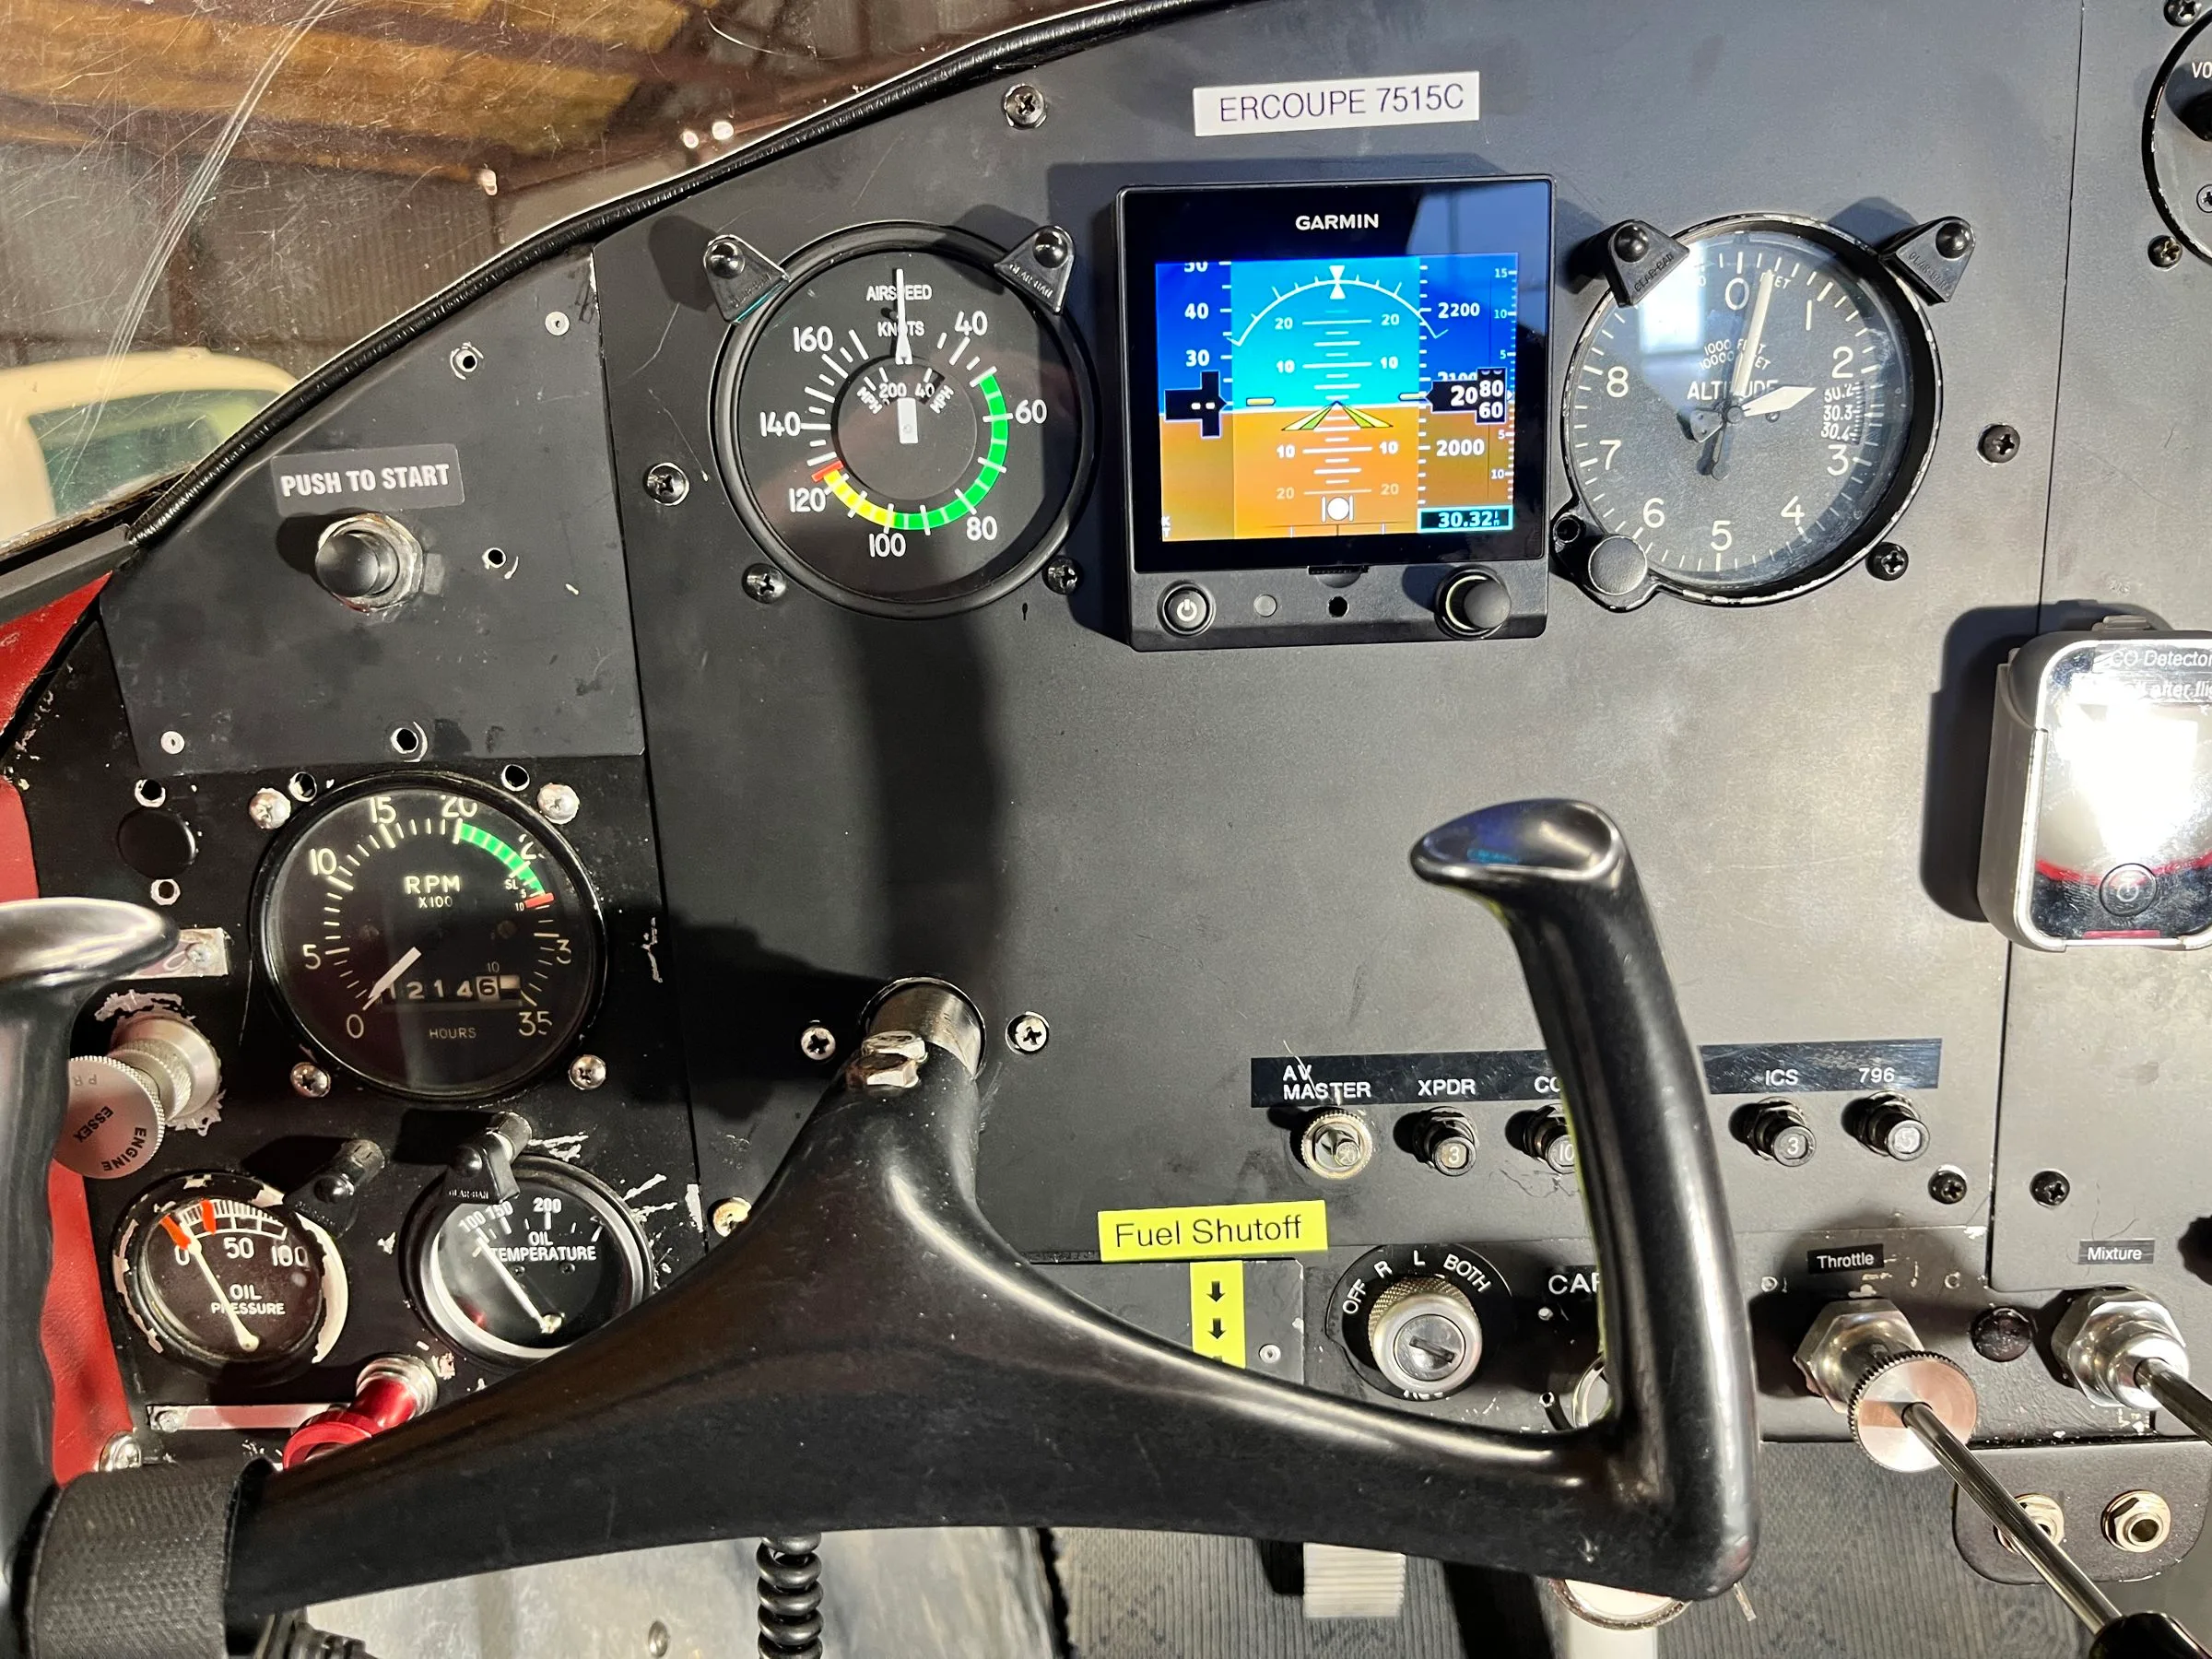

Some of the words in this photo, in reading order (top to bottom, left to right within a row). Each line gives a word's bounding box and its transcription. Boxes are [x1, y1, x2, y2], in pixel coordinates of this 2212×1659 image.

[1220, 88, 1366, 123] ERCOUPE
[1376, 83, 1465, 113] 7515C
[1295, 213, 1380, 230] GARMIN
[1495, 267, 1507, 278] 15
[865, 284, 933, 301] AIRSEED
[1724, 277, 1749, 311] 0
[1184, 302, 1208, 320] 40
[1438, 301, 1480, 319] 2200
[1494, 309, 1506, 320] 10
[1806, 299, 1812, 331] 1
[955, 310, 988, 336] 40
[1275, 317, 1293, 330] 20
[1382, 313, 1400, 326] 20
[877, 321, 925, 337] KNTS
[794, 325, 834, 352] 160
[1704, 339, 1732, 356] 1000
[1736, 338, 1766, 355] FT
[1186, 349, 1209, 367] 30
[1380, 356, 1399, 370] 10
[1500, 349, 1507, 359] 5
[1700, 350, 1734, 371] 10000
[1832, 347, 1853, 379] 2
[1277, 359, 1295, 373] 10
[878, 382, 908, 399] 200
[915, 382, 935, 398] 40
[1606, 366, 1629, 398] 8
[856, 386, 883, 415] MPH
[929, 384, 955, 414] MPH
[1014, 399, 1047, 424] 60
[1823, 404, 1853, 421] 30.3
[759, 411, 801, 437] 140
[1820, 421, 1850, 441] 30.4
[1498, 429, 1505, 440] 5
[1277, 444, 1296, 458] 10
[1379, 441, 1399, 454] 10
[1436, 439, 1485, 456] 2000
[1599, 439, 1622, 471] 7
[1827, 443, 1849, 477] 3
[280, 471, 342, 498] PUSH
[346, 468, 377, 492] TO
[380, 464, 451, 489] START
[1490, 469, 1505, 479] 10
[1277, 487, 1295, 500] 20
[1381, 483, 1399, 496] 20
[789, 488, 827, 513] 120
[1642, 497, 1665, 529] 6
[1781, 495, 1805, 525] 4
[966, 515, 997, 541] 80
[1438, 512, 1492, 527] 30.32
[1711, 520, 1732, 551] 5
[868, 534, 907, 558] 100
[2112, 649, 2138, 667] CO
[370, 795, 397, 824] 15
[309, 848, 337, 877] 10
[405, 875, 461, 895] RPM
[504, 878, 519, 890] SL
[418, 895, 453, 909] X100
[515, 902, 525, 912] 10
[301, 943, 321, 970] 5
[346, 1014, 365, 1039] 0
[519, 1010, 553, 1037] 35
[429, 1027, 477, 1040] HOURS
[1282, 1064, 1312, 1082] AV
[1765, 1069, 1799, 1086] ICS
[1858, 1067, 1895, 1084] 796
[1283, 1081, 1371, 1100] MASTER
[1418, 1078, 1477, 1097] XPDR
[73, 1106, 114, 1143] ESSEX
[100, 1126, 147, 1171] ENGINE
[1787, 1136, 1799, 1156] 3
[1901, 1132, 1912, 1147] 5
[1449, 1146, 1465, 1168] 3
[1559, 1143, 1574, 1161] 10
[485, 1200, 513, 1220] 150
[533, 1197, 562, 1214] 200
[458, 1210, 487, 1233] 100
[528, 1230, 554, 1246] OIL
[1115, 1219, 1181, 1248] Fuel
[1192, 1214, 1302, 1244] Shutoff
[174, 1244, 190, 1265] 0
[223, 1237, 254, 1259] 50
[271, 1244, 308, 1266] 100
[2087, 1246, 2142, 1262] Mixture
[1413, 1250, 1426, 1266] L
[1817, 1251, 1874, 1269] Throttle
[1373, 1260, 1394, 1278] R
[1442, 1253, 1492, 1293] BOTH
[229, 1284, 263, 1300] OIL
[1342, 1278, 1367, 1314] OFF
